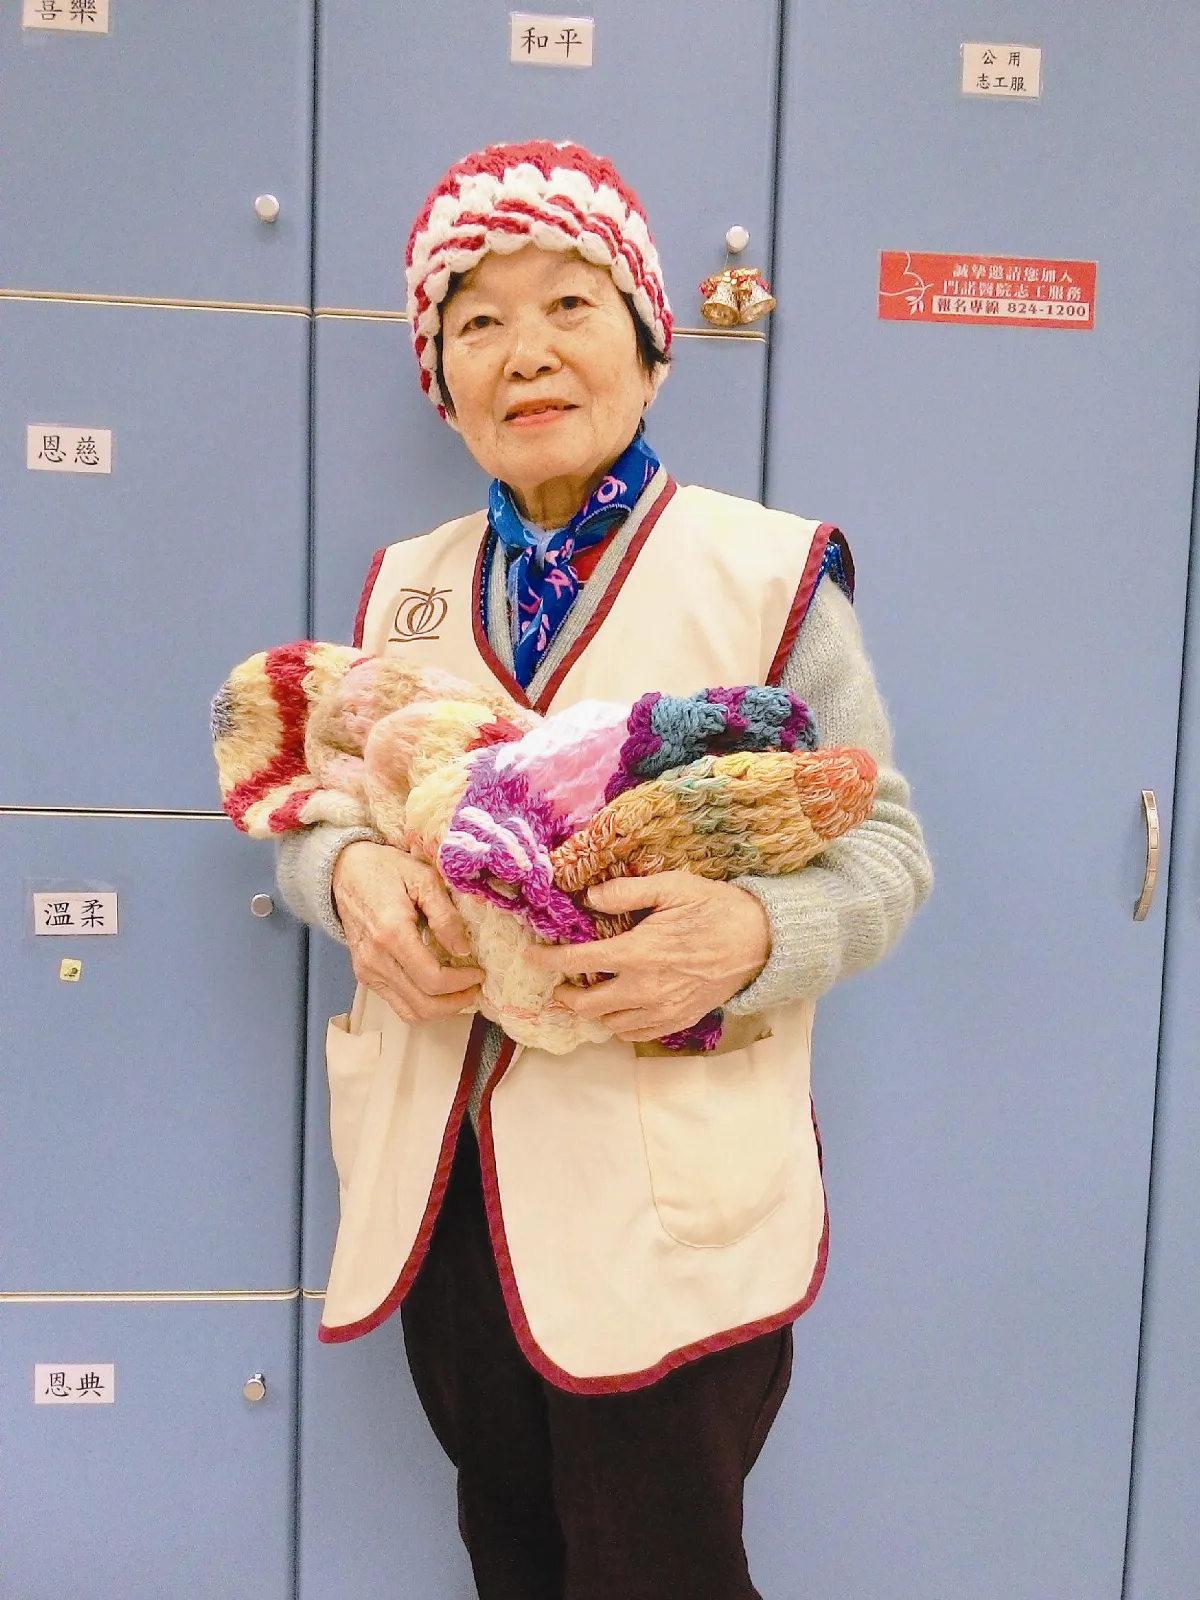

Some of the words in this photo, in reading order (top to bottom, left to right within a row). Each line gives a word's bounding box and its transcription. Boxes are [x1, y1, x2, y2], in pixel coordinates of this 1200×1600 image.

[34, 0, 97, 24] 喜樂
[520, 26, 582, 58] 和平
[982, 49, 1021, 67] 公用
[976, 73, 1027, 92] 志工服
[952, 263, 1073, 283] 誠摯邀請您加入
[943, 280, 1082, 301] 門諾醫院志工服務
[938, 297, 1000, 314] 報名專線
[1007, 302, 1086, 317] 824-1200
[38, 435, 100, 465] 恩慈
[44, 899, 104, 928] 溫柔
[45, 1371, 105, 1397] 恩典
